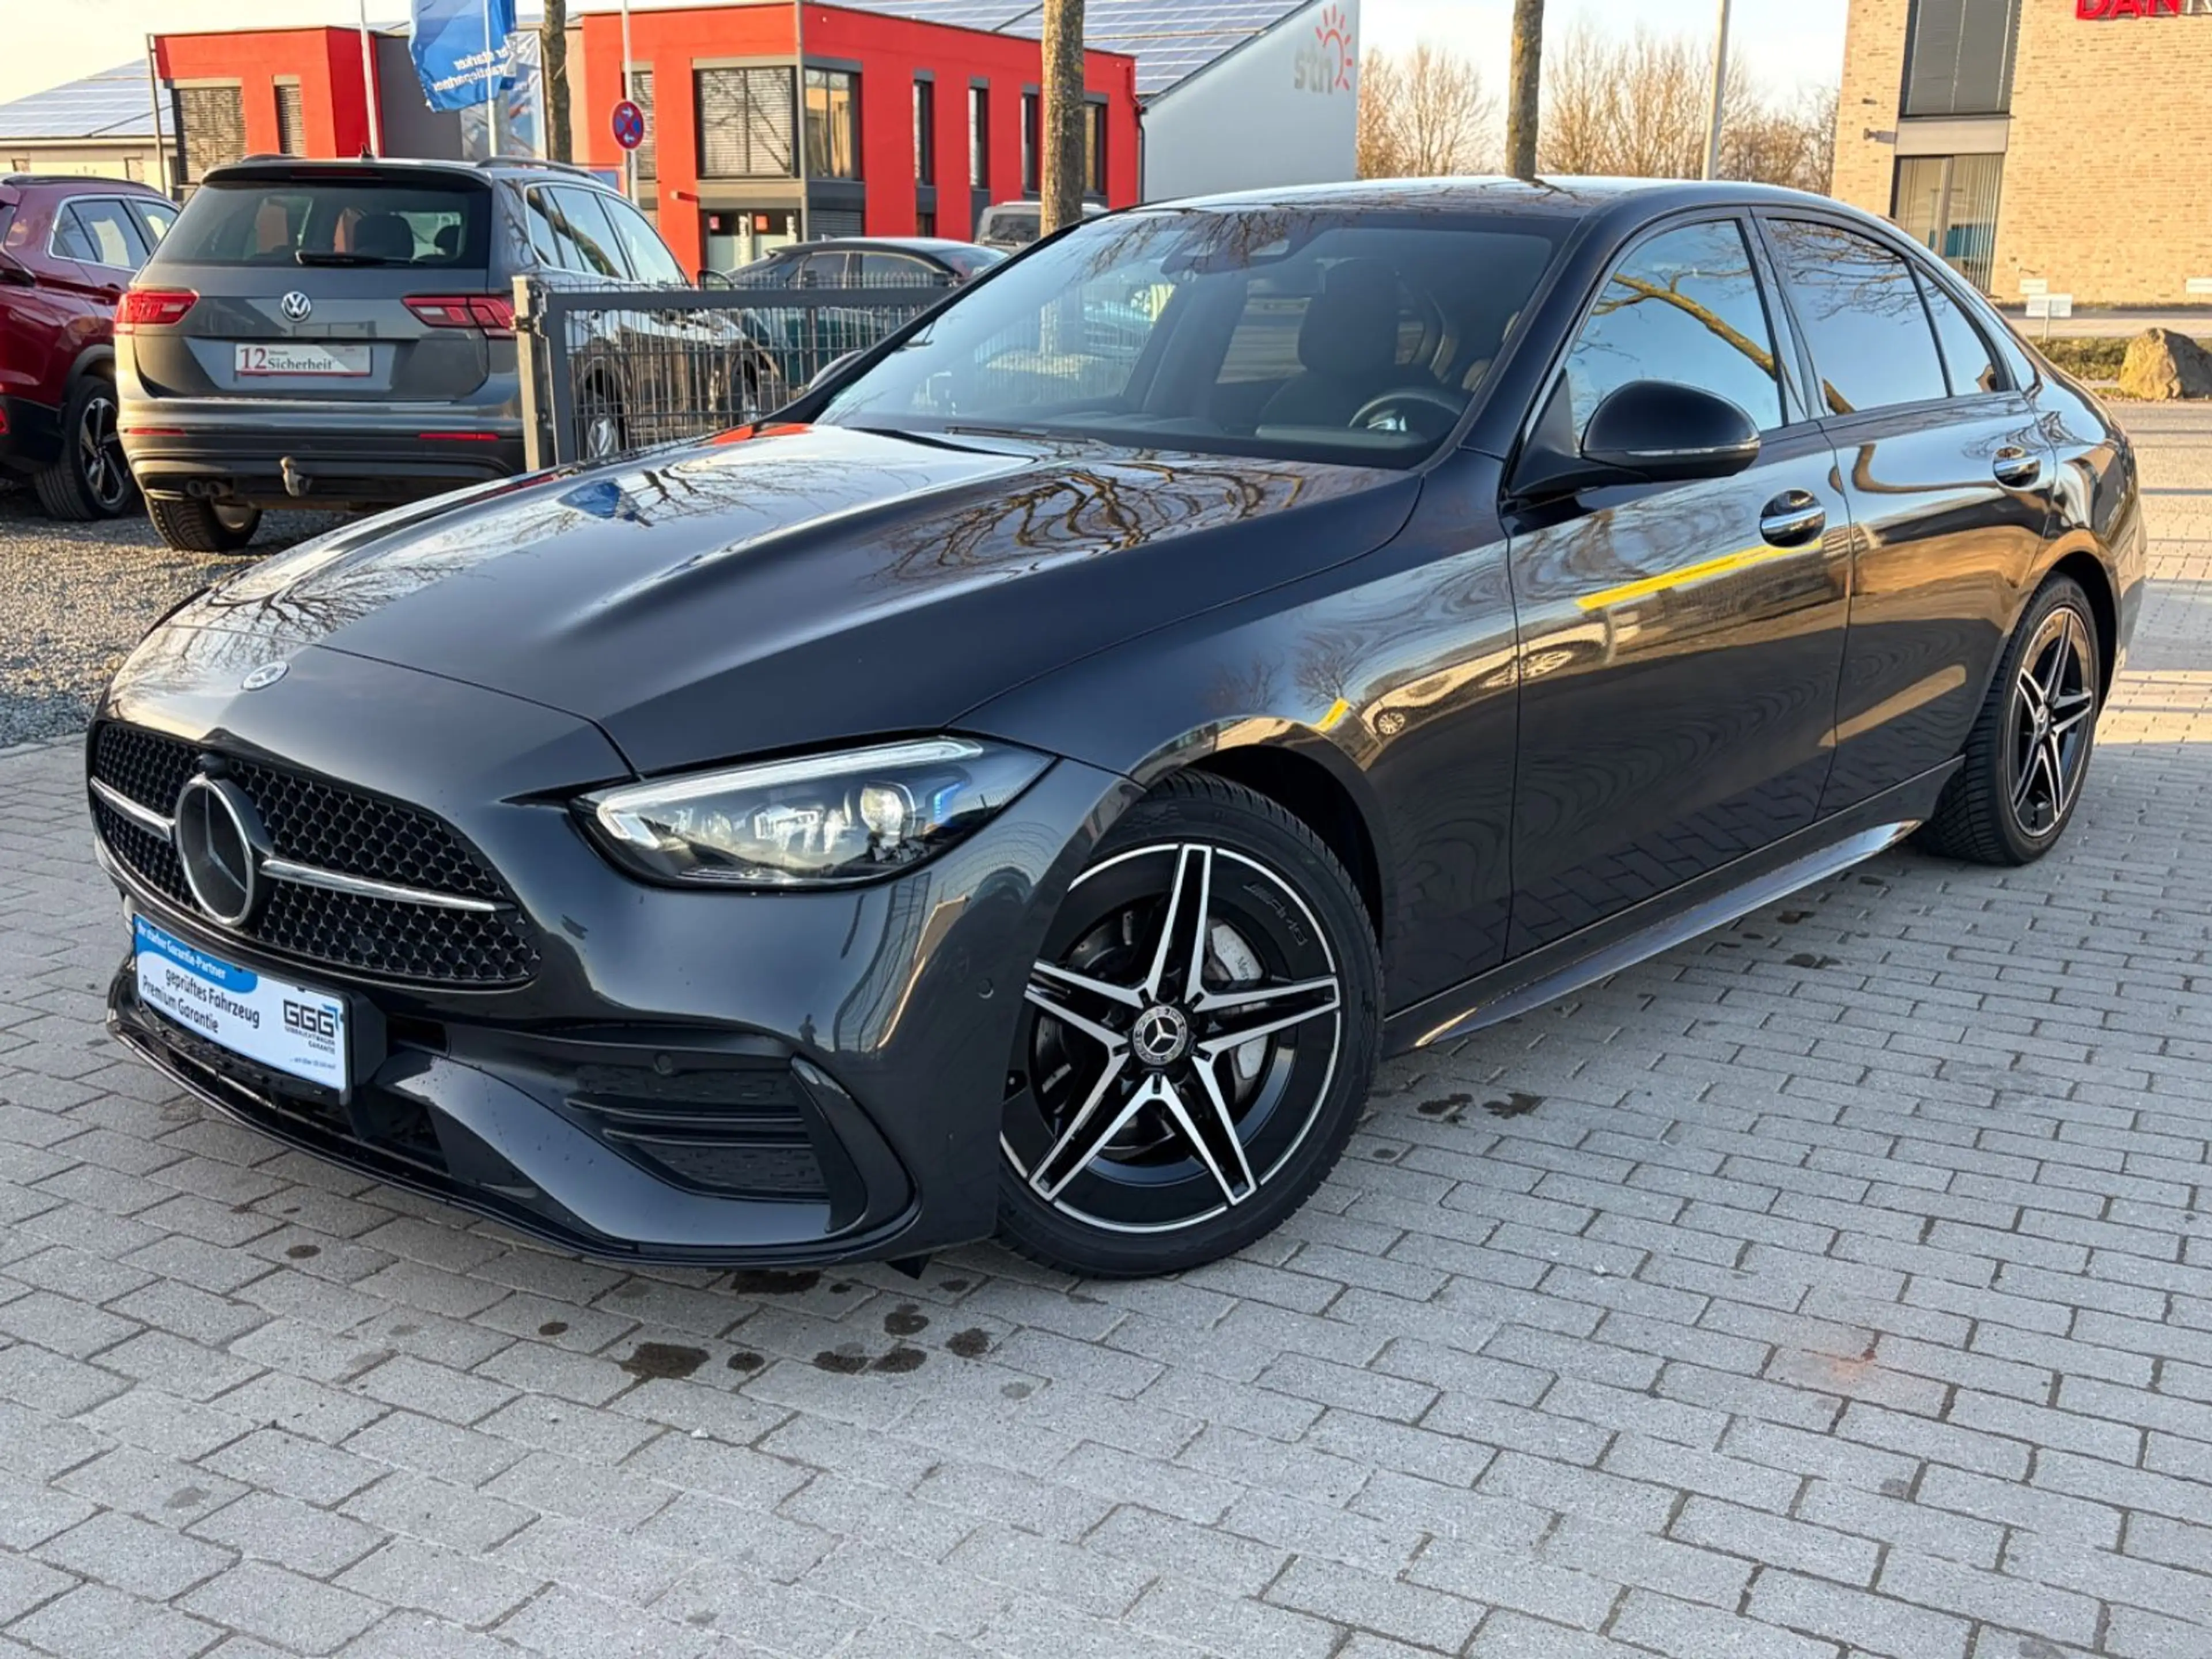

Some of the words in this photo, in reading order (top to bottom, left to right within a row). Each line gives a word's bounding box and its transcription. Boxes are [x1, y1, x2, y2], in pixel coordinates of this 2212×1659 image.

[240, 347, 267, 370] 12
[268, 357, 333, 370] Sicherheit
[142, 974, 176, 1008] Premium
[177, 997, 219, 1034] Garantie
[166, 968, 207, 1003] geprüftes
[209, 988, 260, 1029] Fahrzeug
[283, 998, 334, 1038] GGG
